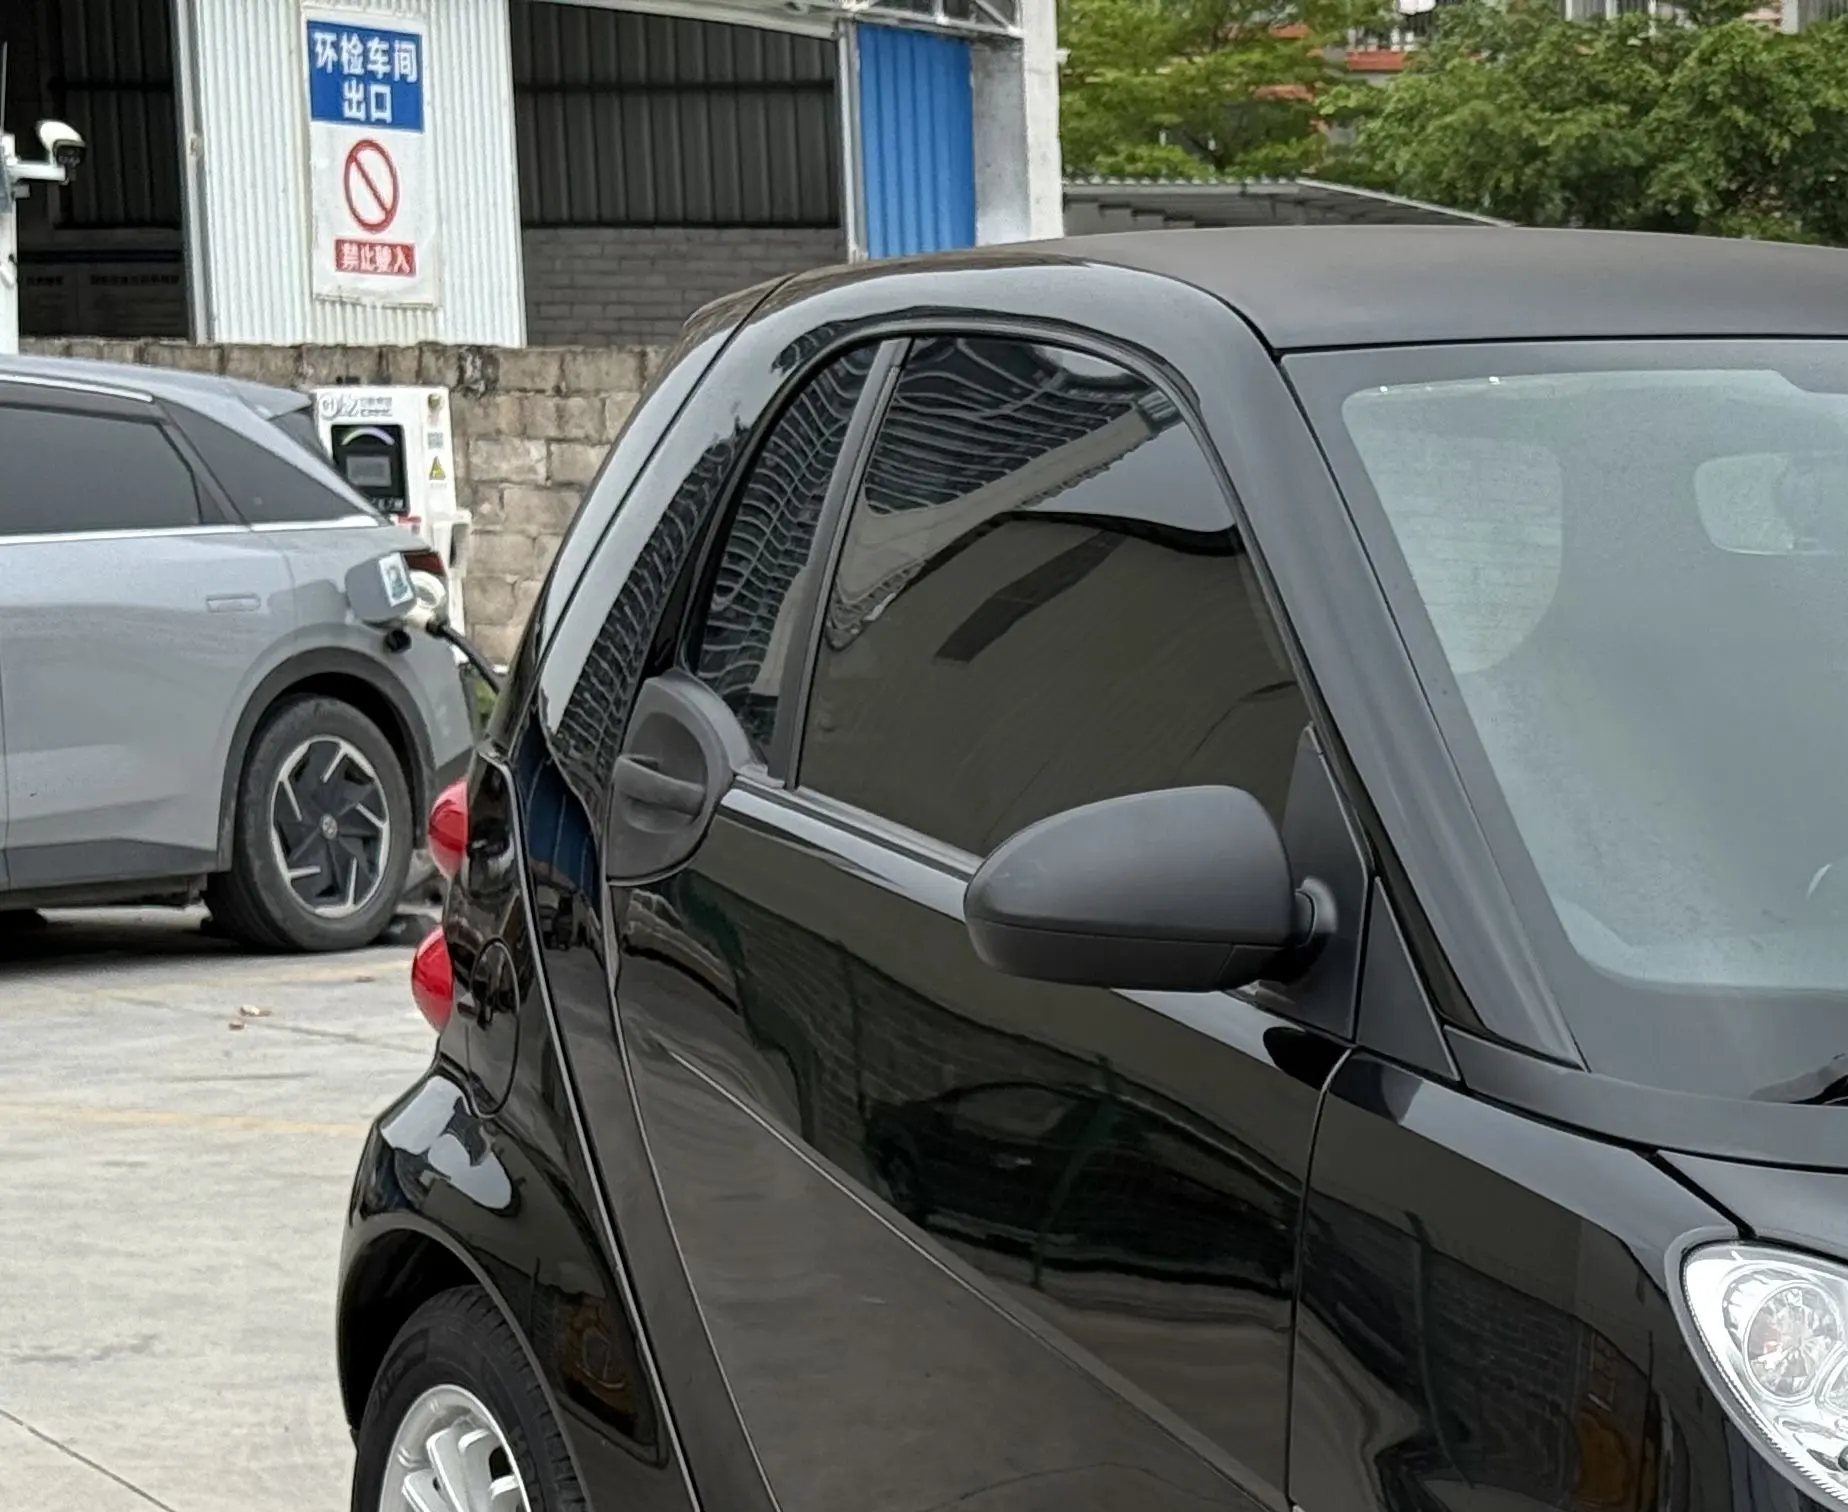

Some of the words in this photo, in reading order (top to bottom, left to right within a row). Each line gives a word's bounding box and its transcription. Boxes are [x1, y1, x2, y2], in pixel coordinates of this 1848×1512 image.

[313, 31, 418, 83] 环检车间
[343, 80, 393, 123] 出口
